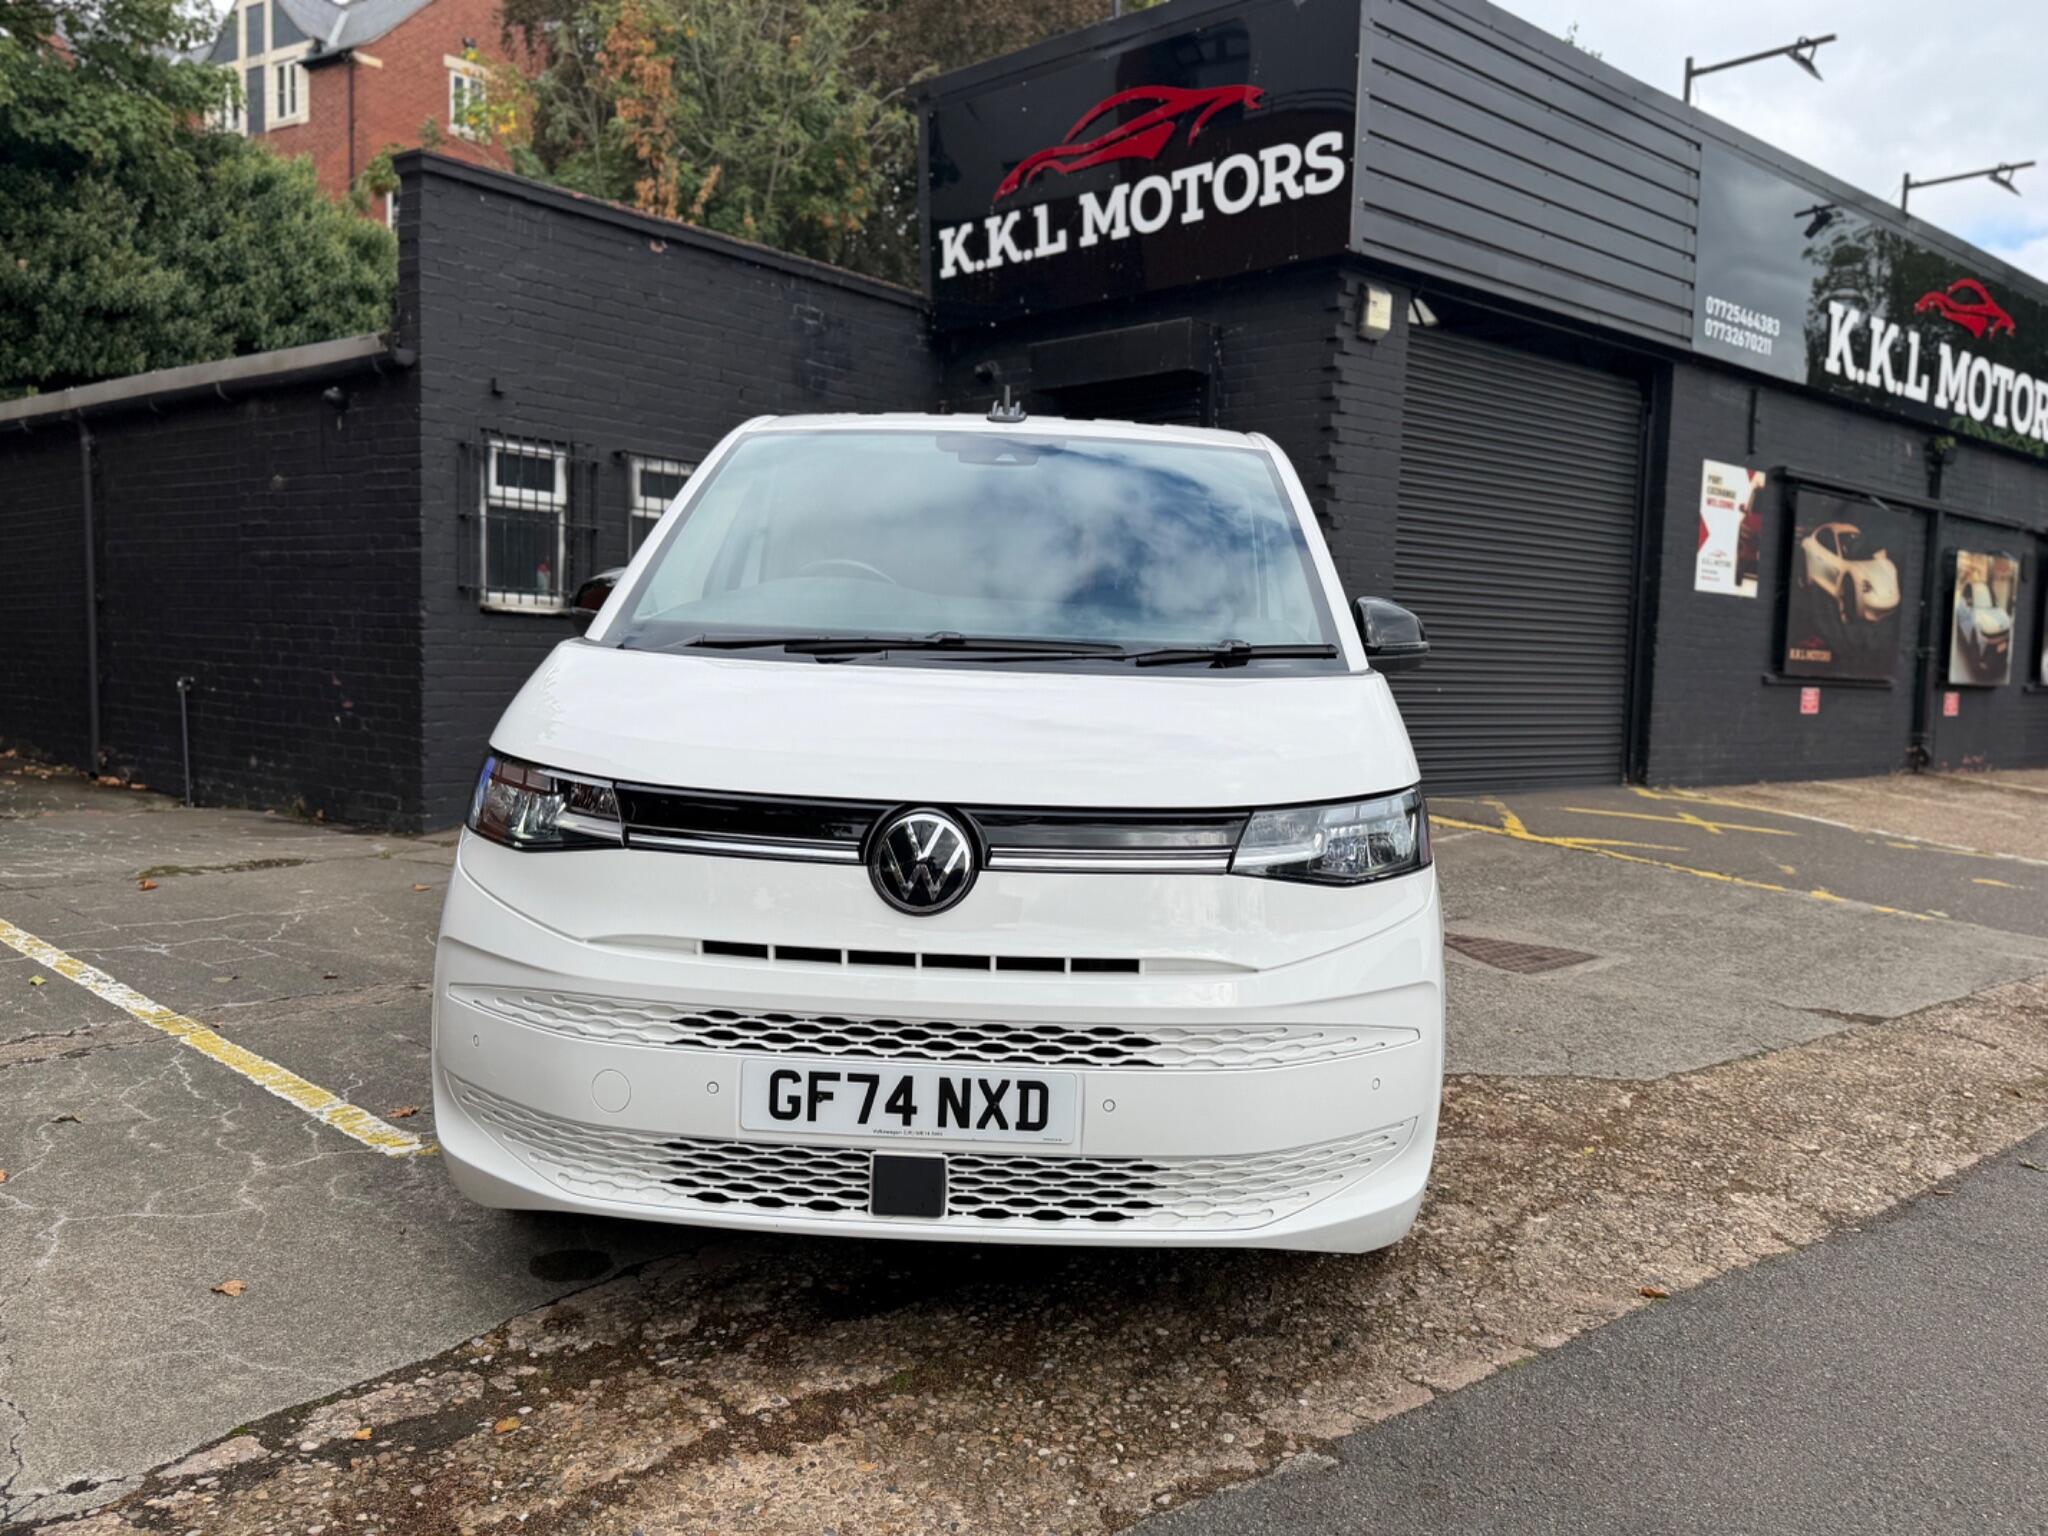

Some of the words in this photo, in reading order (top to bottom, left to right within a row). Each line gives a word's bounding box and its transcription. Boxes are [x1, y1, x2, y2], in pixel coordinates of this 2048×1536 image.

[939, 203, 1067, 279] K.K.L
[1079, 131, 1345, 247] MOTORS
[1825, 300, 1930, 403] K.K.L
[769, 1069, 918, 1127] GF74
[937, 1076, 1049, 1132] NXD
